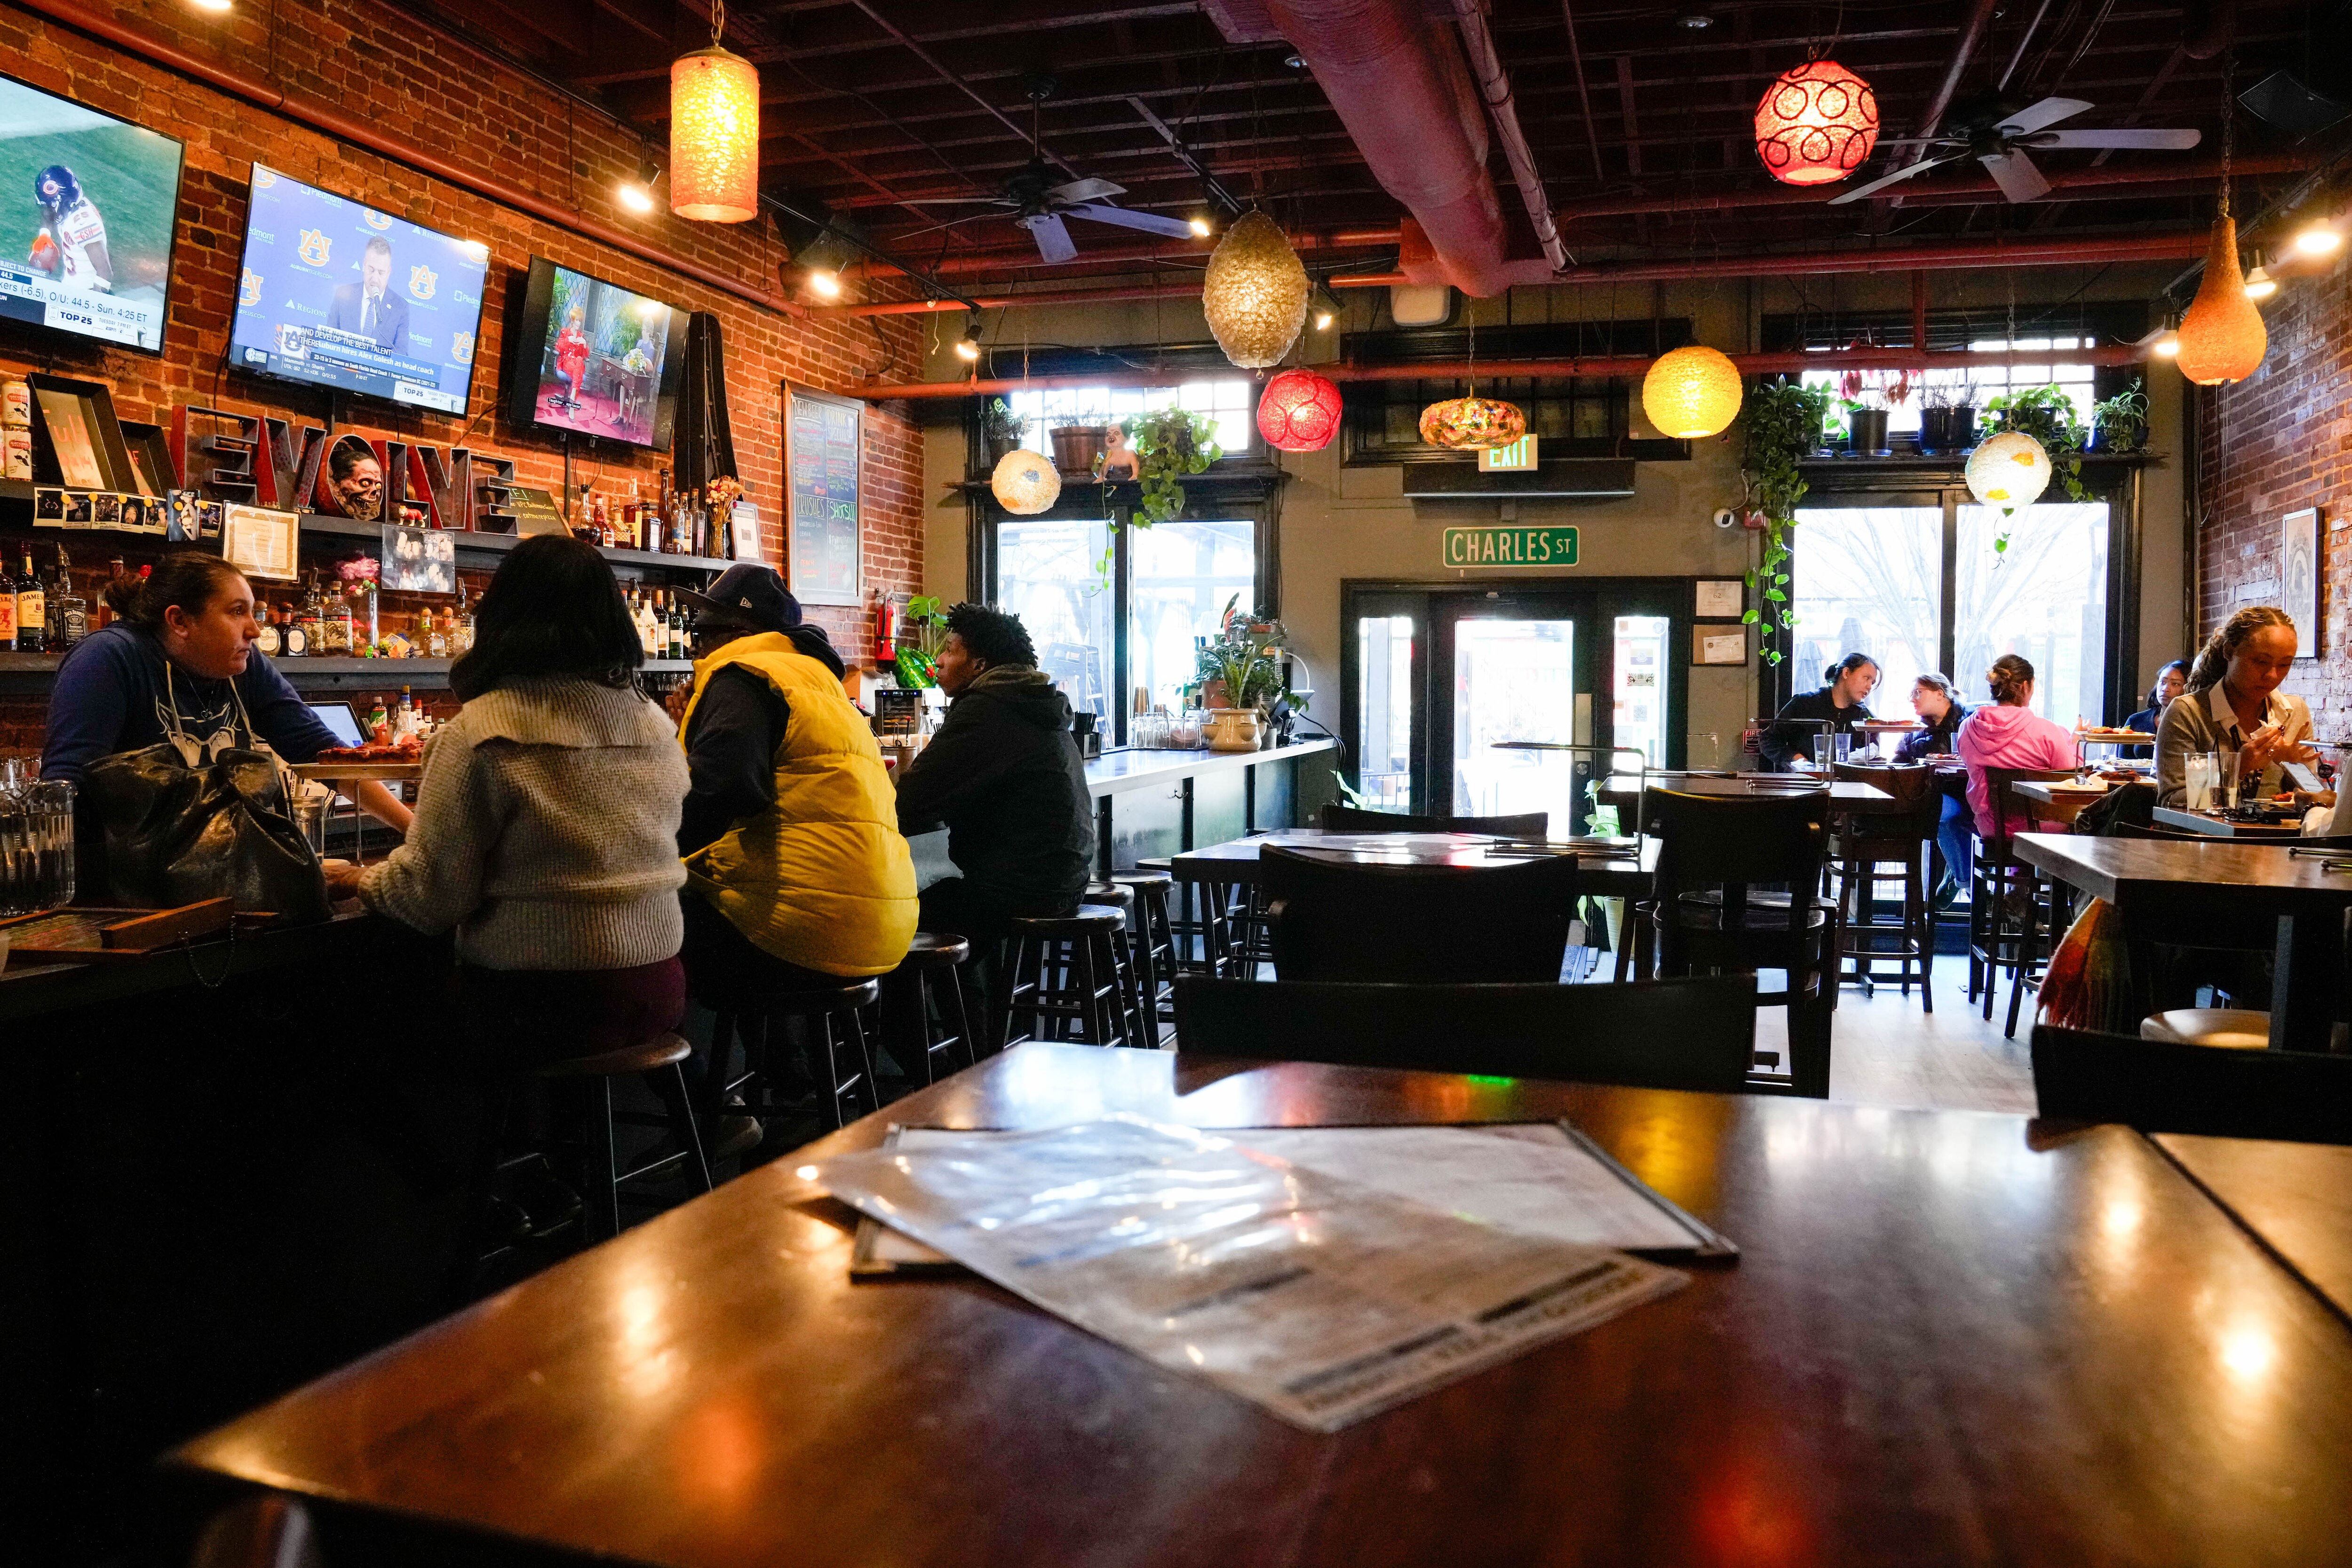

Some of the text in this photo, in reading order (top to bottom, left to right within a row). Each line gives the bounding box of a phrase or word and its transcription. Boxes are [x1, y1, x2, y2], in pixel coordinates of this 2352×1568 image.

[26, 267, 47, 278] CHANGE
[49, 292, 69, 304] O/U:
[72, 297, 90, 309] 44.5
[97, 303, 115, 315] Sun.
[118, 309, 135, 320] 4:25
[137, 313, 147, 322] ET
[60, 311, 92, 325] TOP 25
[299, 336, 319, 348] THERE
[301, 327, 392, 357] AND DEVELOP THE BEST TALENT
[284, 358, 305, 366] Mammoth
[342, 345, 358, 357] hires
[358, 351, 373, 360] Alex
[373, 355, 394, 366] Golesh
[402, 362, 417, 371] head
[417, 365, 434, 375] coach
[795, 400, 822, 420] NEW BEER
[827, 408, 847, 426] DRINK
[828, 426, 850, 442] SPECIALS
[1489, 436, 1529, 467] EXIT
[177, 405, 519, 537] EVOLVE
[797, 494, 825, 518] CRUSHES
[1452, 532, 1571, 562] CHARLES ST
[72, 609, 85, 619] DANIEL'S
